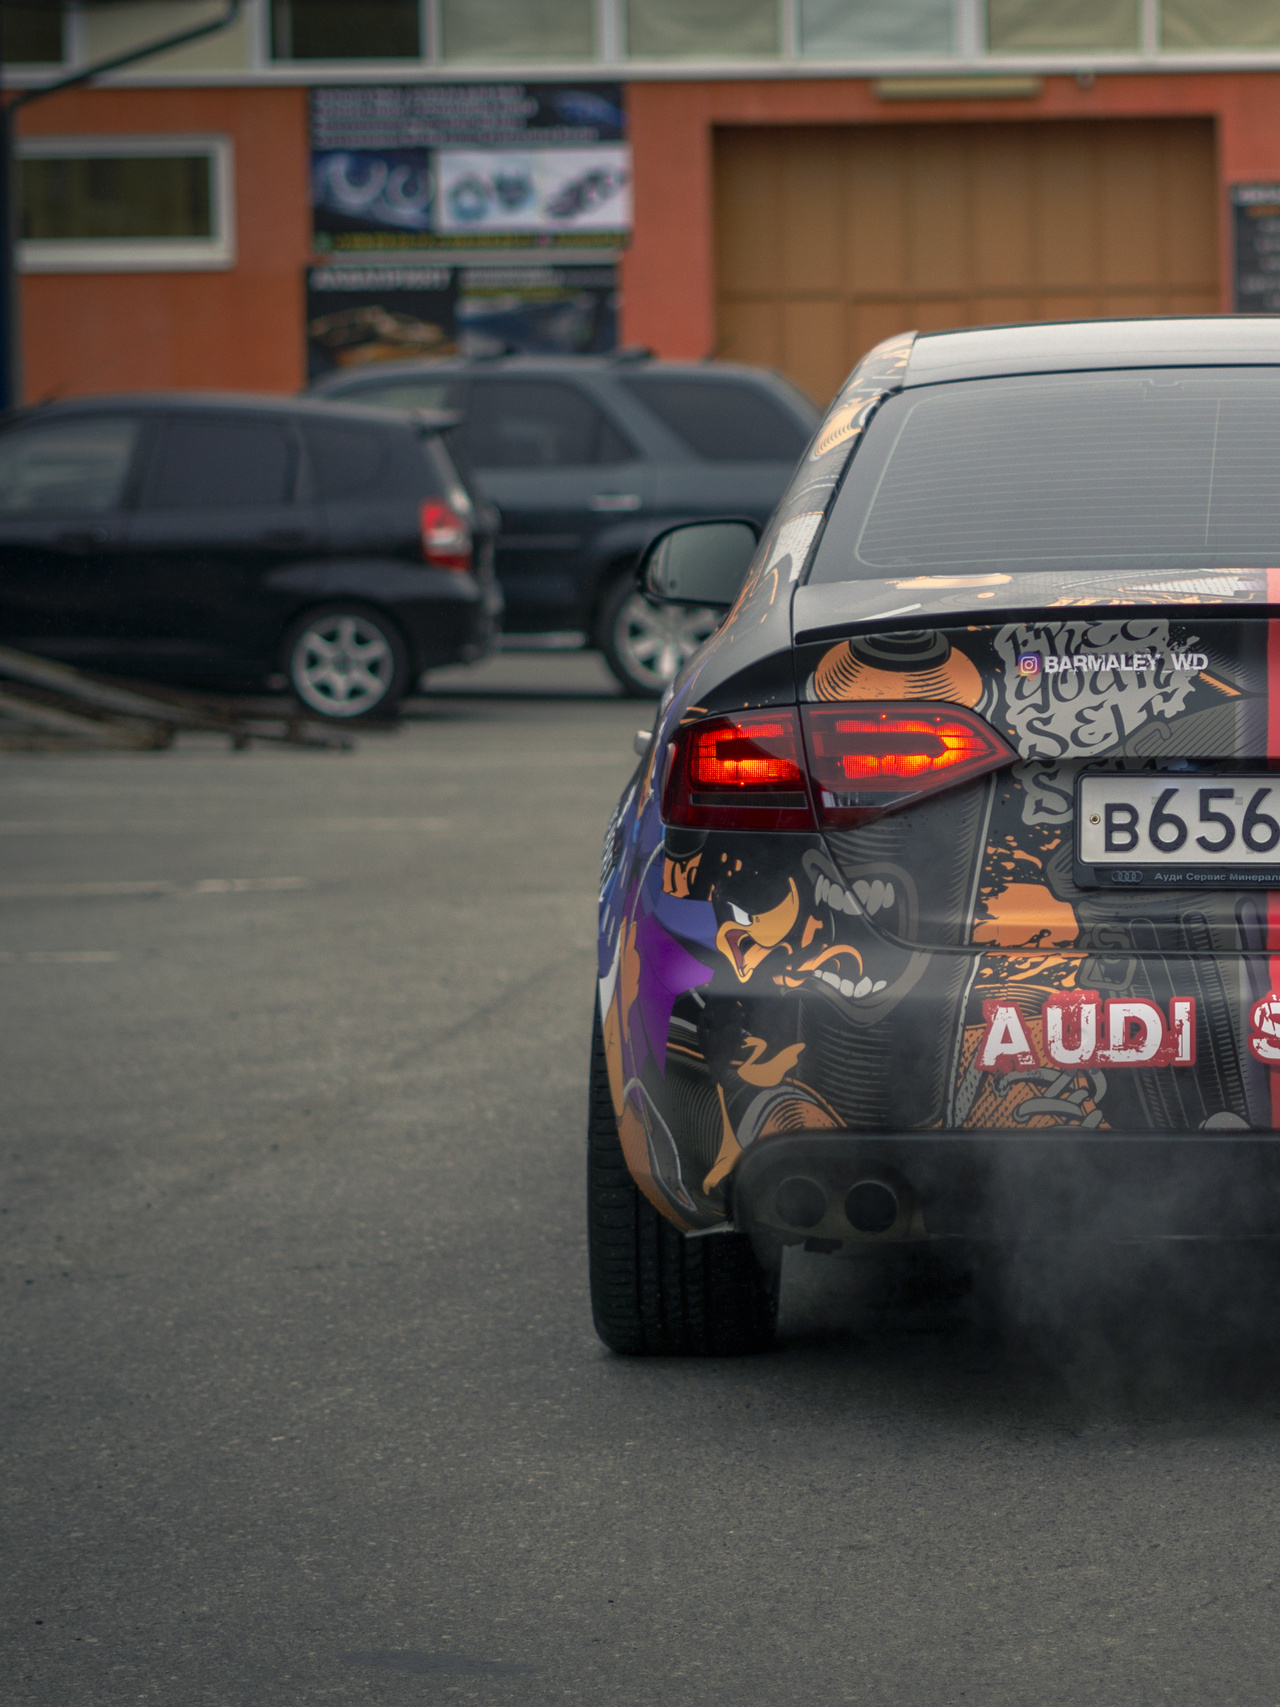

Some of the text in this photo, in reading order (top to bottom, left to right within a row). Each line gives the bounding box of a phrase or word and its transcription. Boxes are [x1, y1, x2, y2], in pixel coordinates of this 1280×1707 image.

[1044, 653, 1209, 674] BARMALEY_WD
[1154, 872, 1183, 882] Ауди
[1186, 872, 1227, 882] Сервис
[981, 999, 1194, 1068] AUDI
